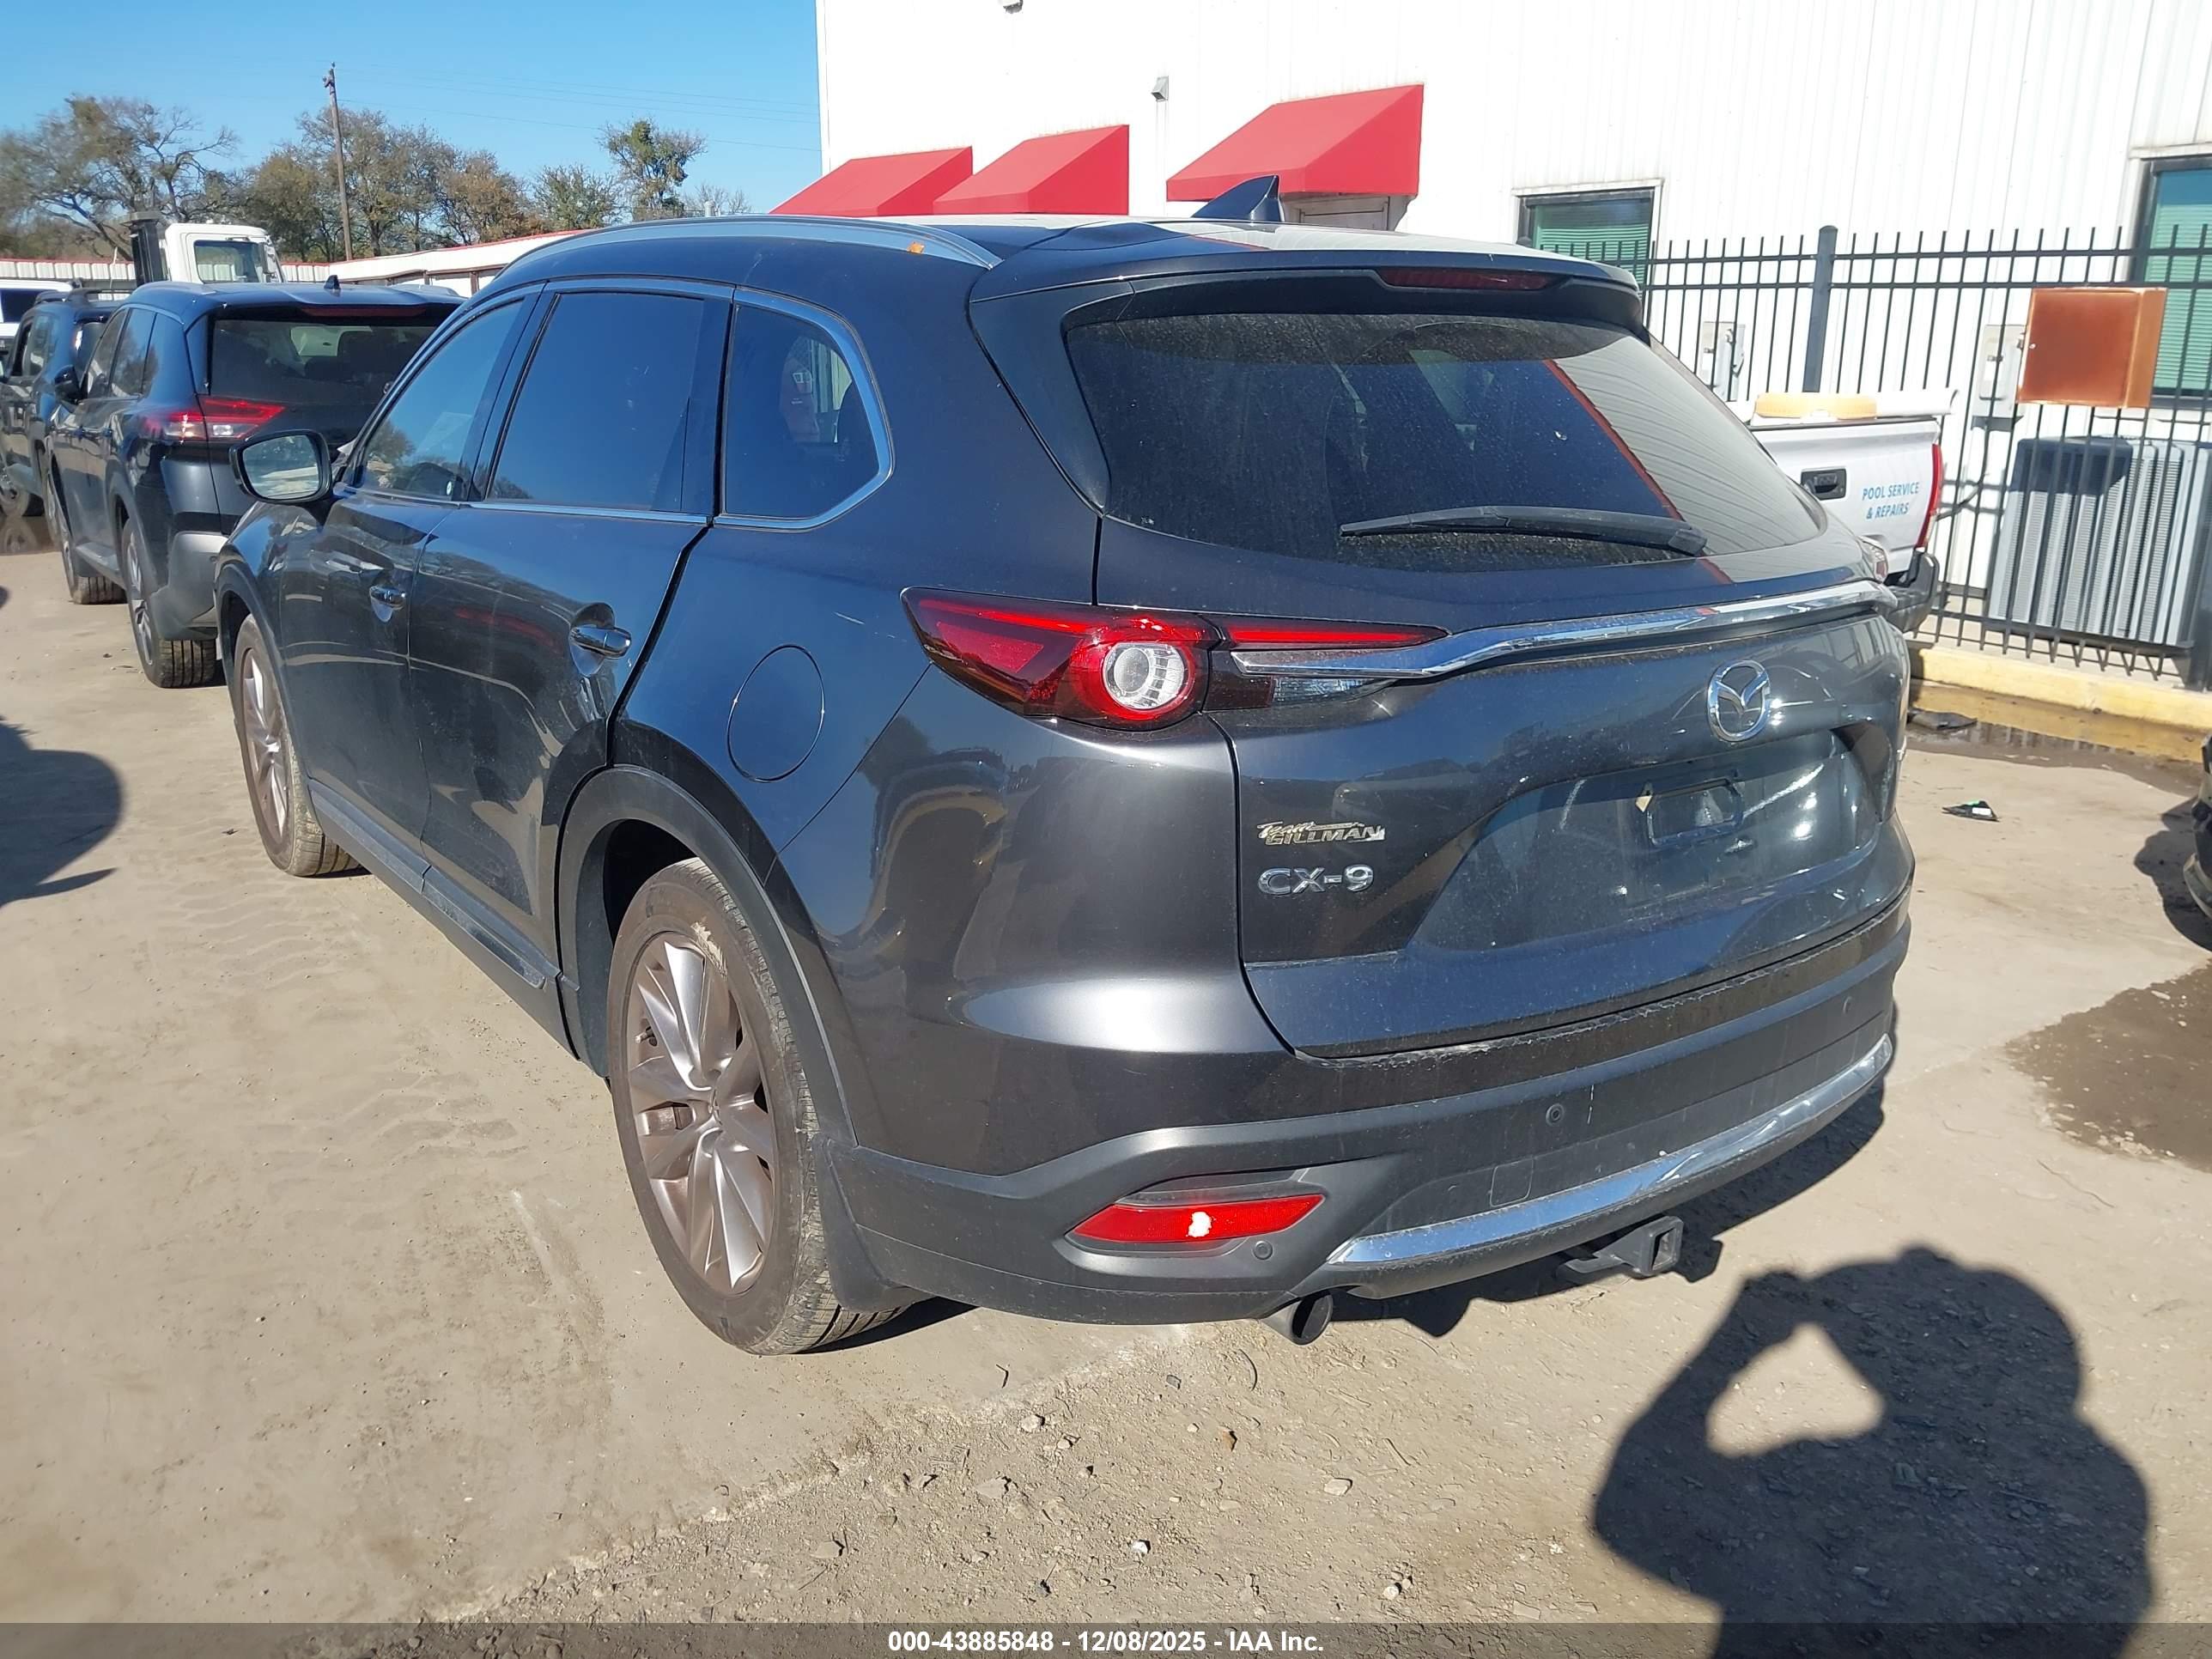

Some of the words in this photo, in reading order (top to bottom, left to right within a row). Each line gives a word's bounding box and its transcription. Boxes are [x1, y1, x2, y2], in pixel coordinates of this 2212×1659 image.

[1862, 487, 1886, 500] POOL
[1888, 483, 1920, 497] SERVICE
[1866, 507, 1872, 520] &
[1875, 502, 1909, 518] REPAIRS
[1265, 825, 1386, 846] GILLMAN
[1258, 864, 1374, 895] CX-9
